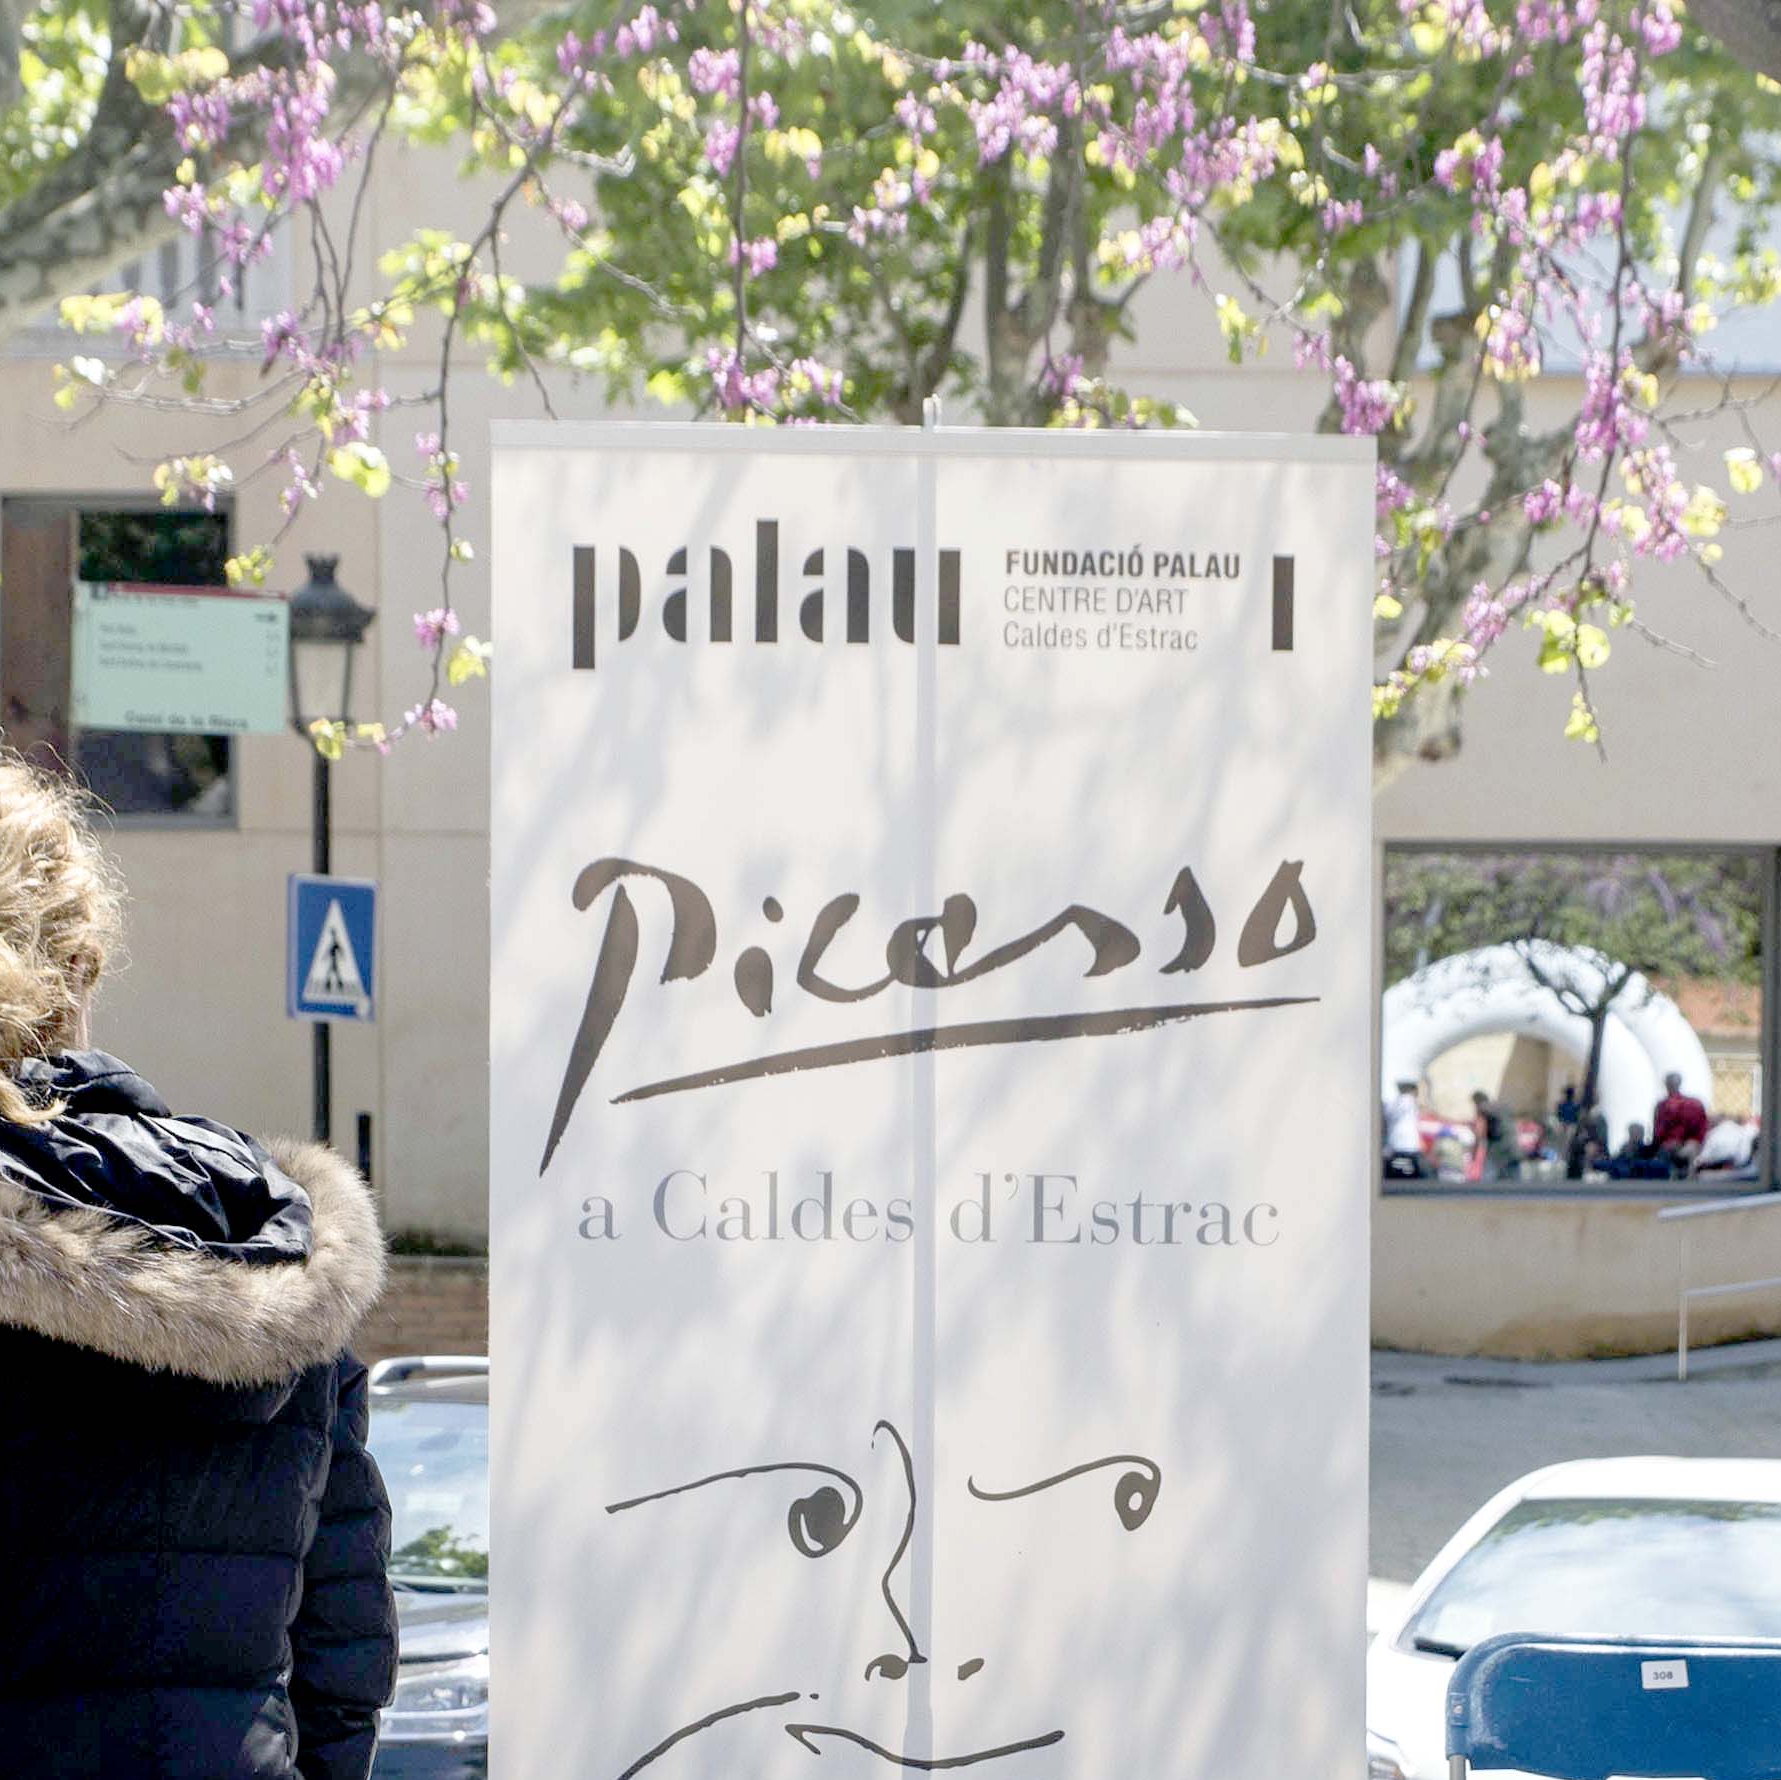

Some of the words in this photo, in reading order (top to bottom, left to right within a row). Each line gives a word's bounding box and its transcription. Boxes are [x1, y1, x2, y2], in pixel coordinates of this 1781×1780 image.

[1006, 544, 1144, 577] FUNDACIÓ
[1154, 553, 1240, 579] PALAU
[573, 519, 961, 669] palau
[1004, 586, 1107, 614] CENTRE
[1117, 587, 1189, 614] D'ART
[1004, 621, 1087, 650] Caldes
[1097, 622, 1198, 651] d'Estrac
[540, 858, 1320, 1176] Picasso
[578, 1196, 622, 1241] a
[652, 1170, 915, 1242] Caldes
[950, 1171, 1281, 1246] d'Estrac
